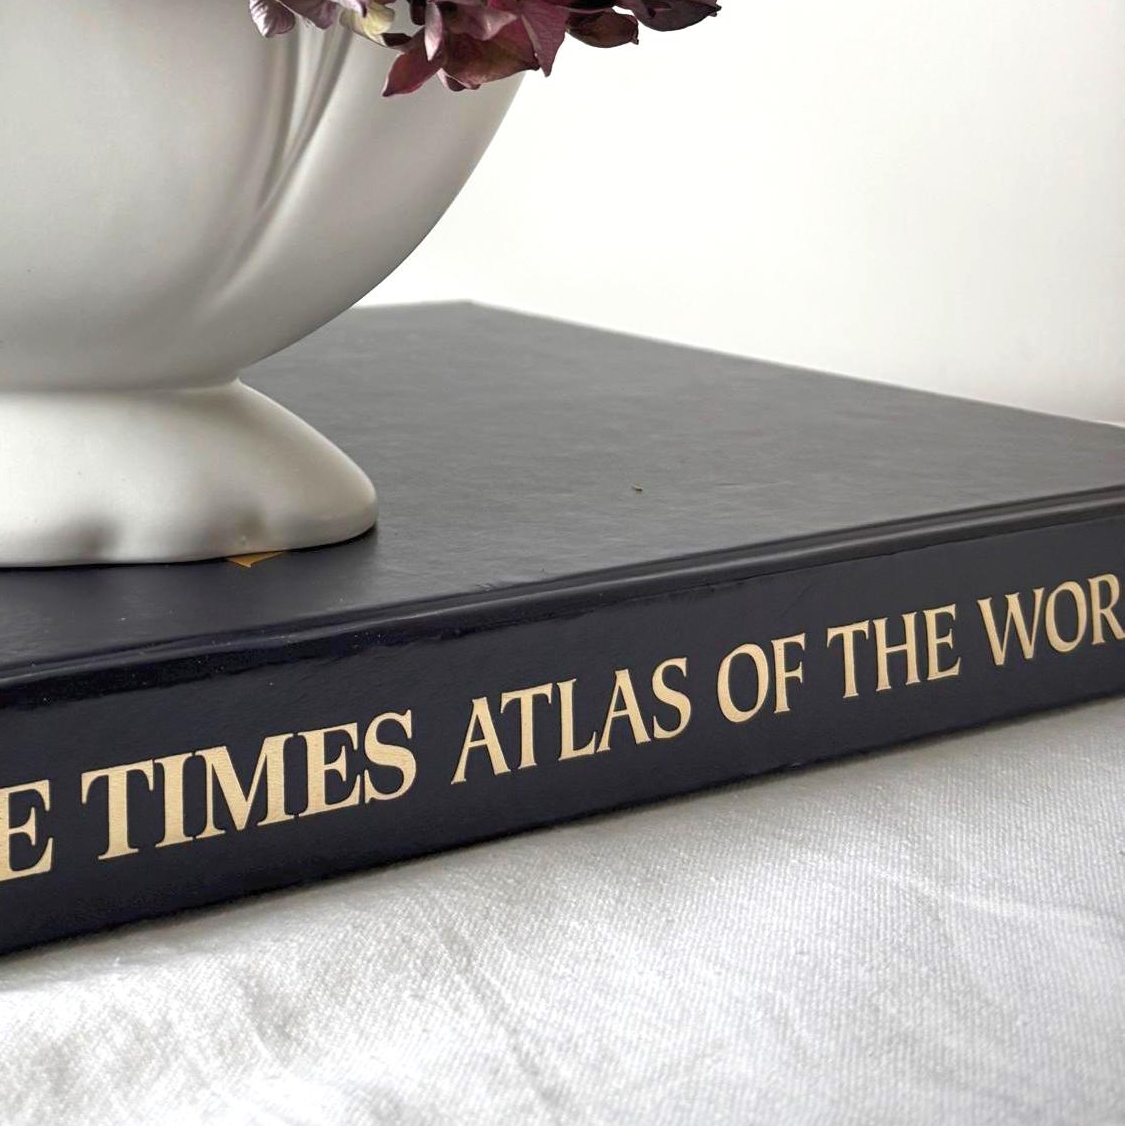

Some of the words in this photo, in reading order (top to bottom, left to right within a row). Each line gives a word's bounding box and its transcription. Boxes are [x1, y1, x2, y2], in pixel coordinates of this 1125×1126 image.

[81, 709, 417, 860] TIMES
[451, 657, 692, 785] ATLAS
[717, 632, 806, 723] OF
[826, 603, 961, 699] THE
[977, 574, 1125, 666] WOR
